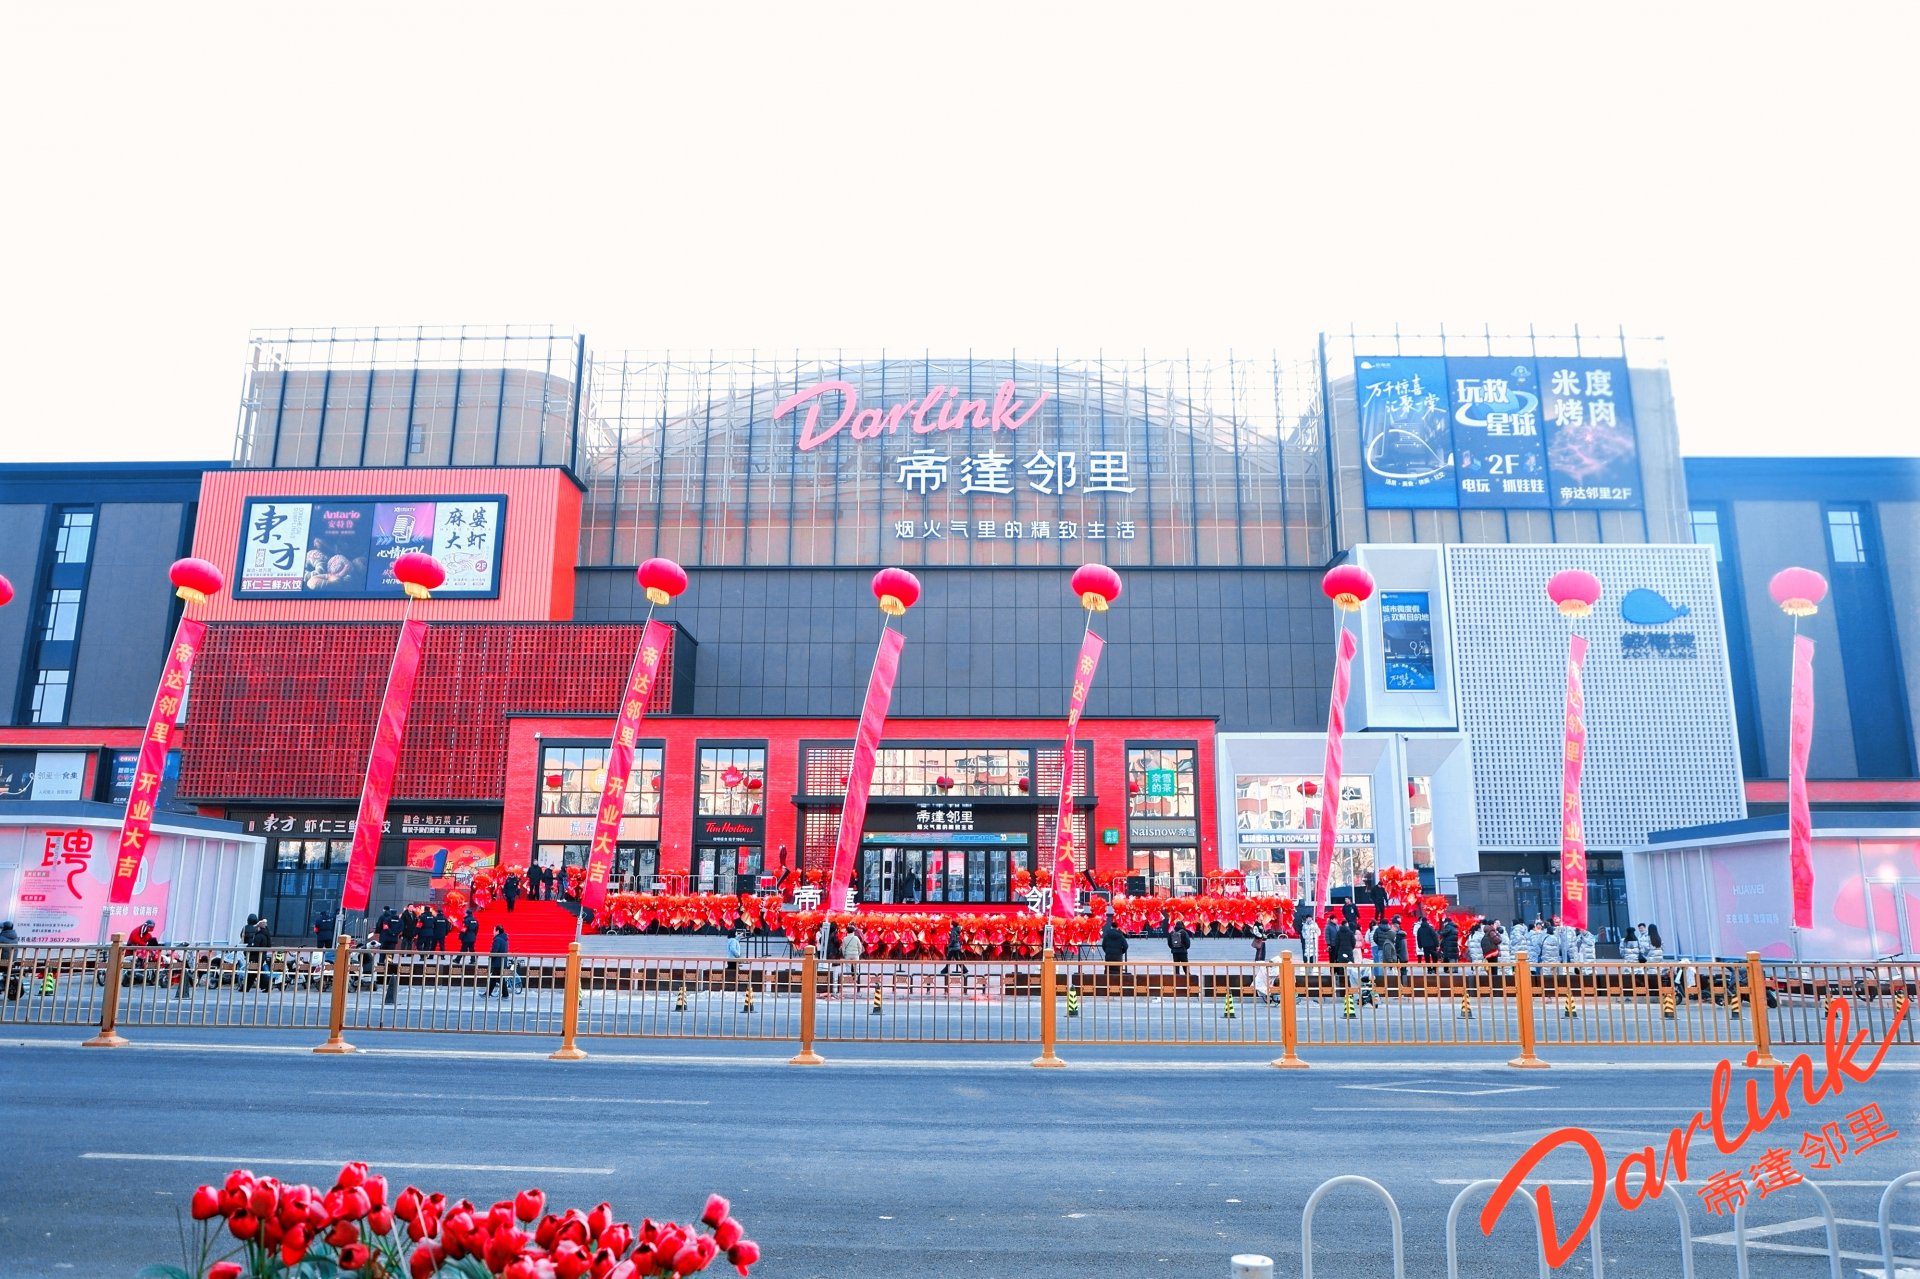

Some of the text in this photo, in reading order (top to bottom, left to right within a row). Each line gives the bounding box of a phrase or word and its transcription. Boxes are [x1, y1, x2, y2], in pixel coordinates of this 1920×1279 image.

[1456, 379, 1509, 403] 玩救
[1552, 369, 1613, 396] 米度
[774, 379, 1050, 450] Darlink
[1487, 412, 1537, 436] 星球
[1554, 400, 1617, 428] 烤肉
[1488, 454, 1519, 474] 2F
[1462, 479, 1545, 492] 电玩 抓娃娃
[445, 507, 488, 528] 麻婆
[895, 519, 1136, 540] 烟火气里的精致生活
[445, 531, 487, 549] 大虾
[242, 580, 302, 590] 虾仁三鲜水饺
[149, 643, 193, 743] 帝达邻里
[617, 646, 658, 747] 帝达邻里
[1151, 773, 1171, 782] 奈雪
[1151, 783, 1171, 792] 的茶
[118, 771, 157, 878] 开业大吉
[589, 776, 624, 883] 开业大吉
[721, 822, 753, 833] Hortons
[41, 828, 94, 900] 聘
